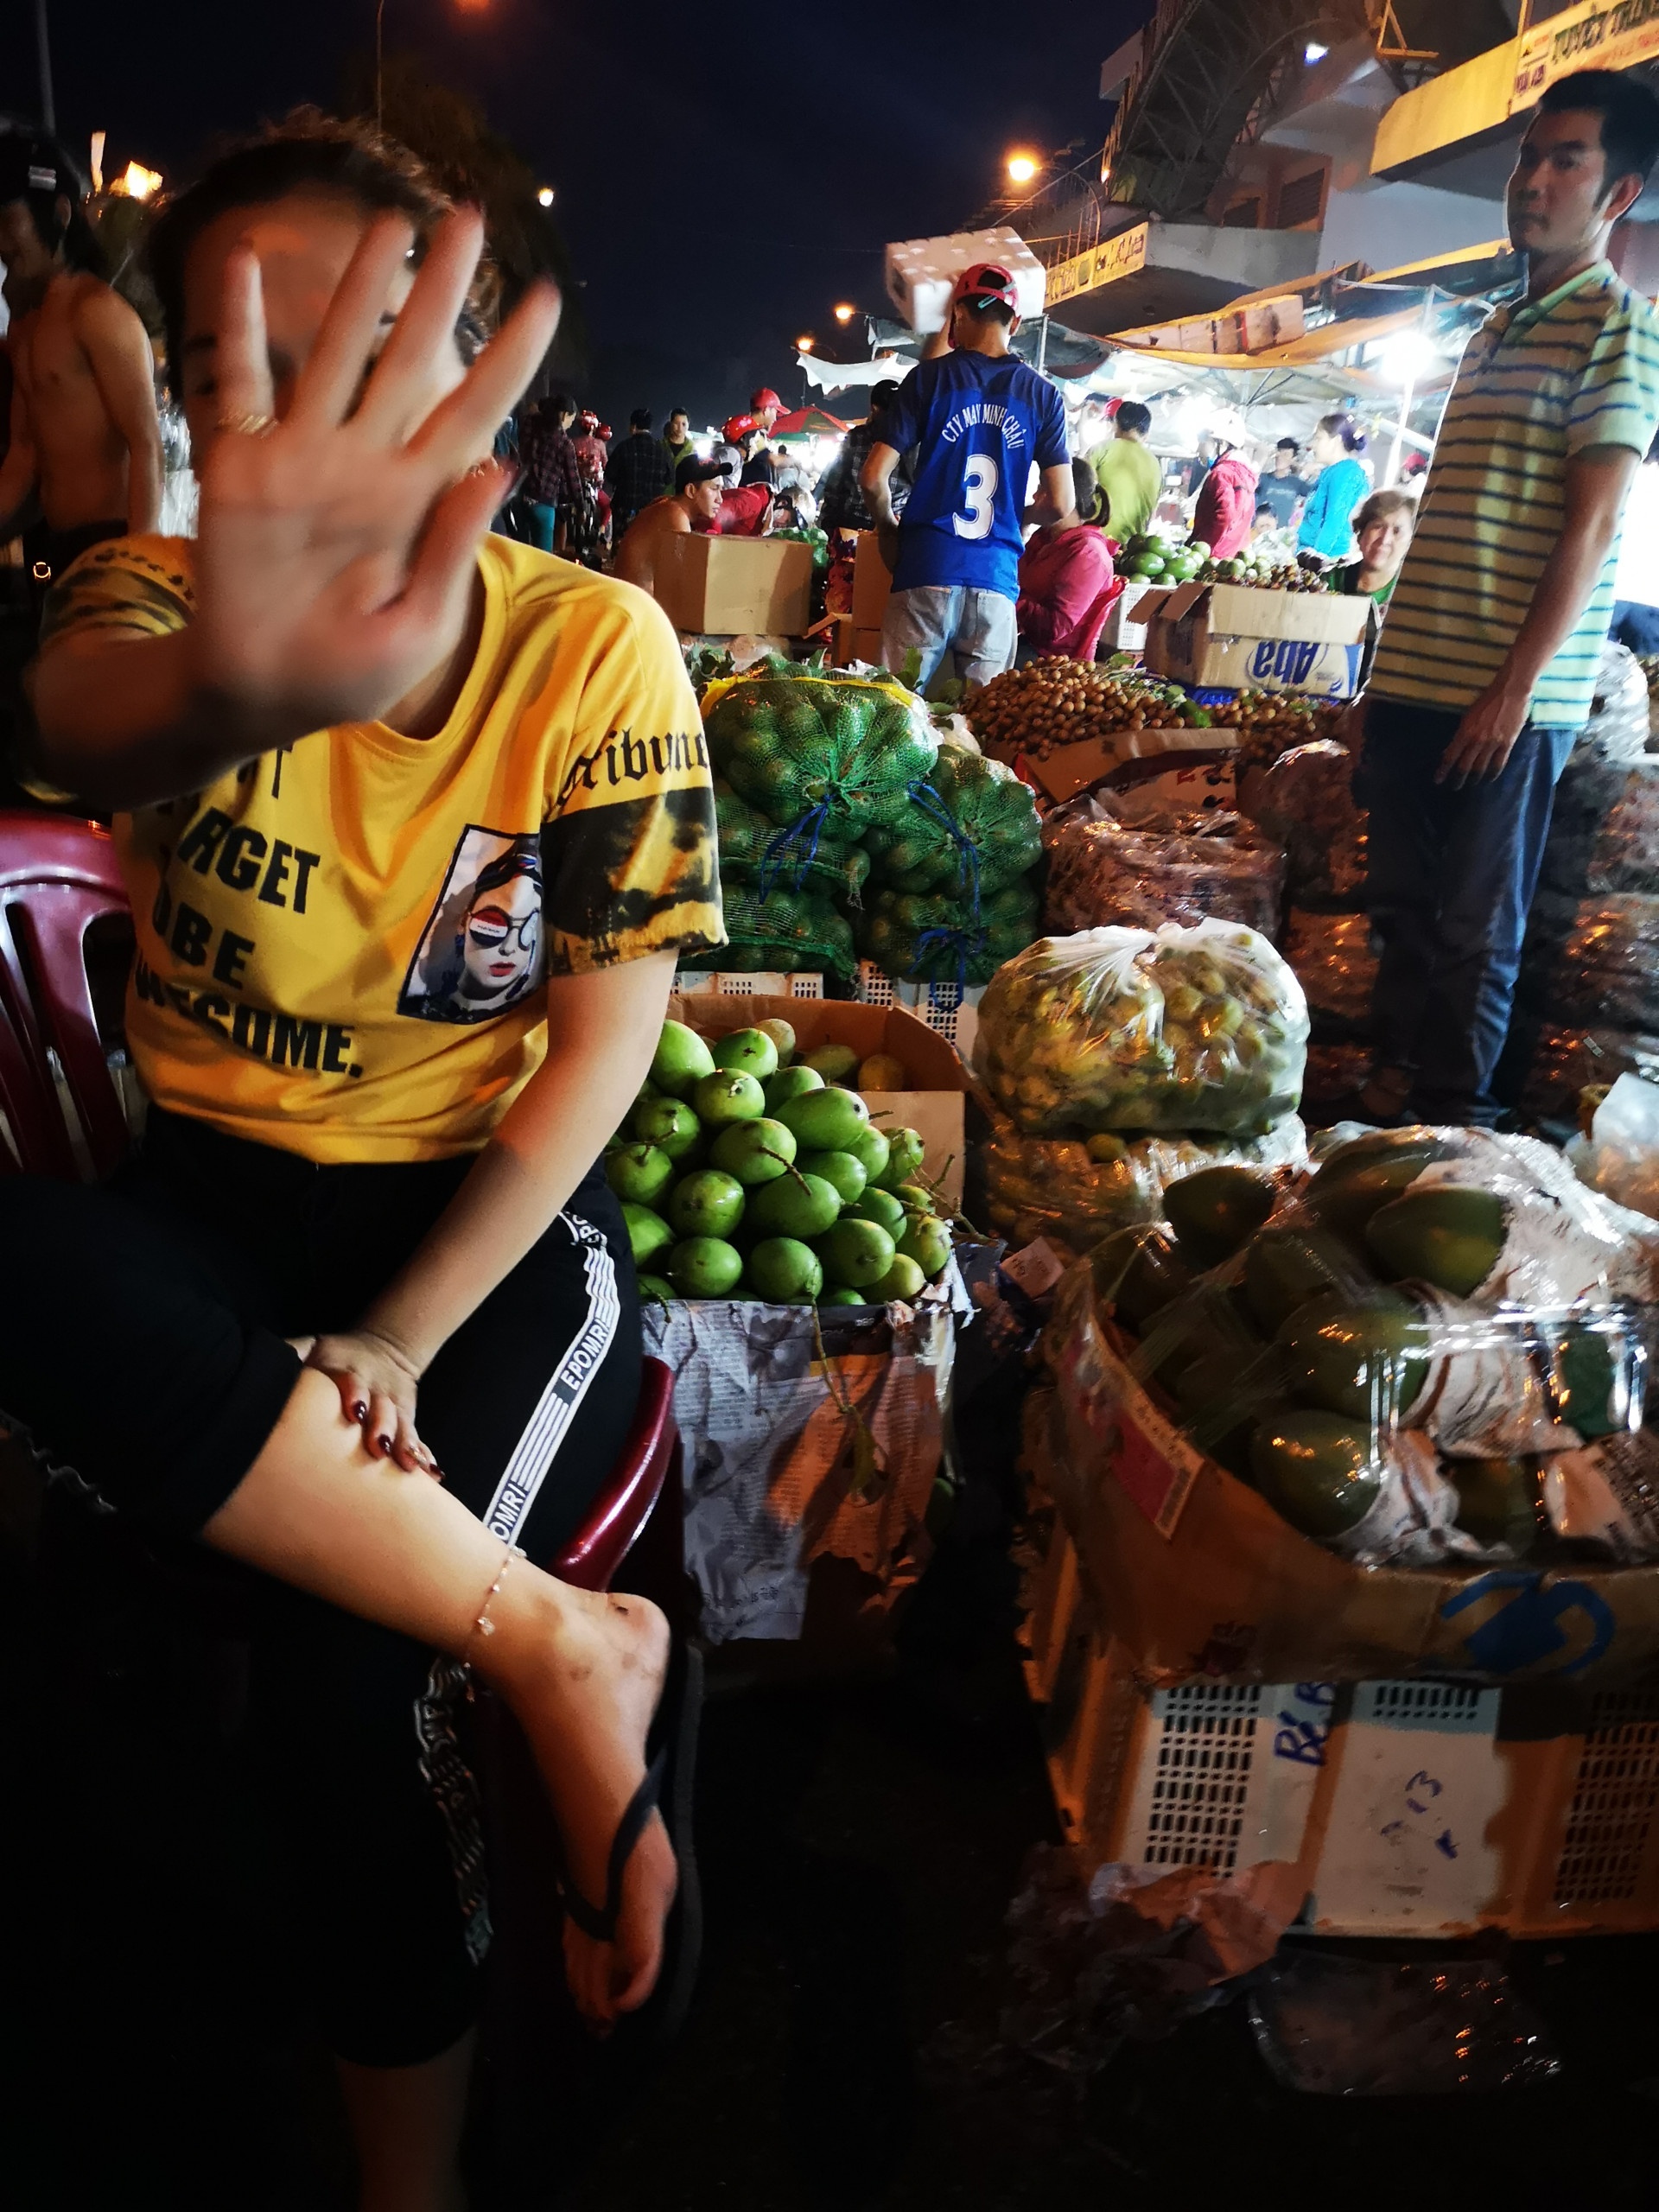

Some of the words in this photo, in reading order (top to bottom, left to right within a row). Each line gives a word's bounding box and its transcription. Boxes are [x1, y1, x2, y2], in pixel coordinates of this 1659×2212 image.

[941, 415, 963, 442] CTY
[982, 404, 1007, 428] MINH
[1001, 415, 1025, 449] CHÂU
[952, 454, 999, 540] 3
